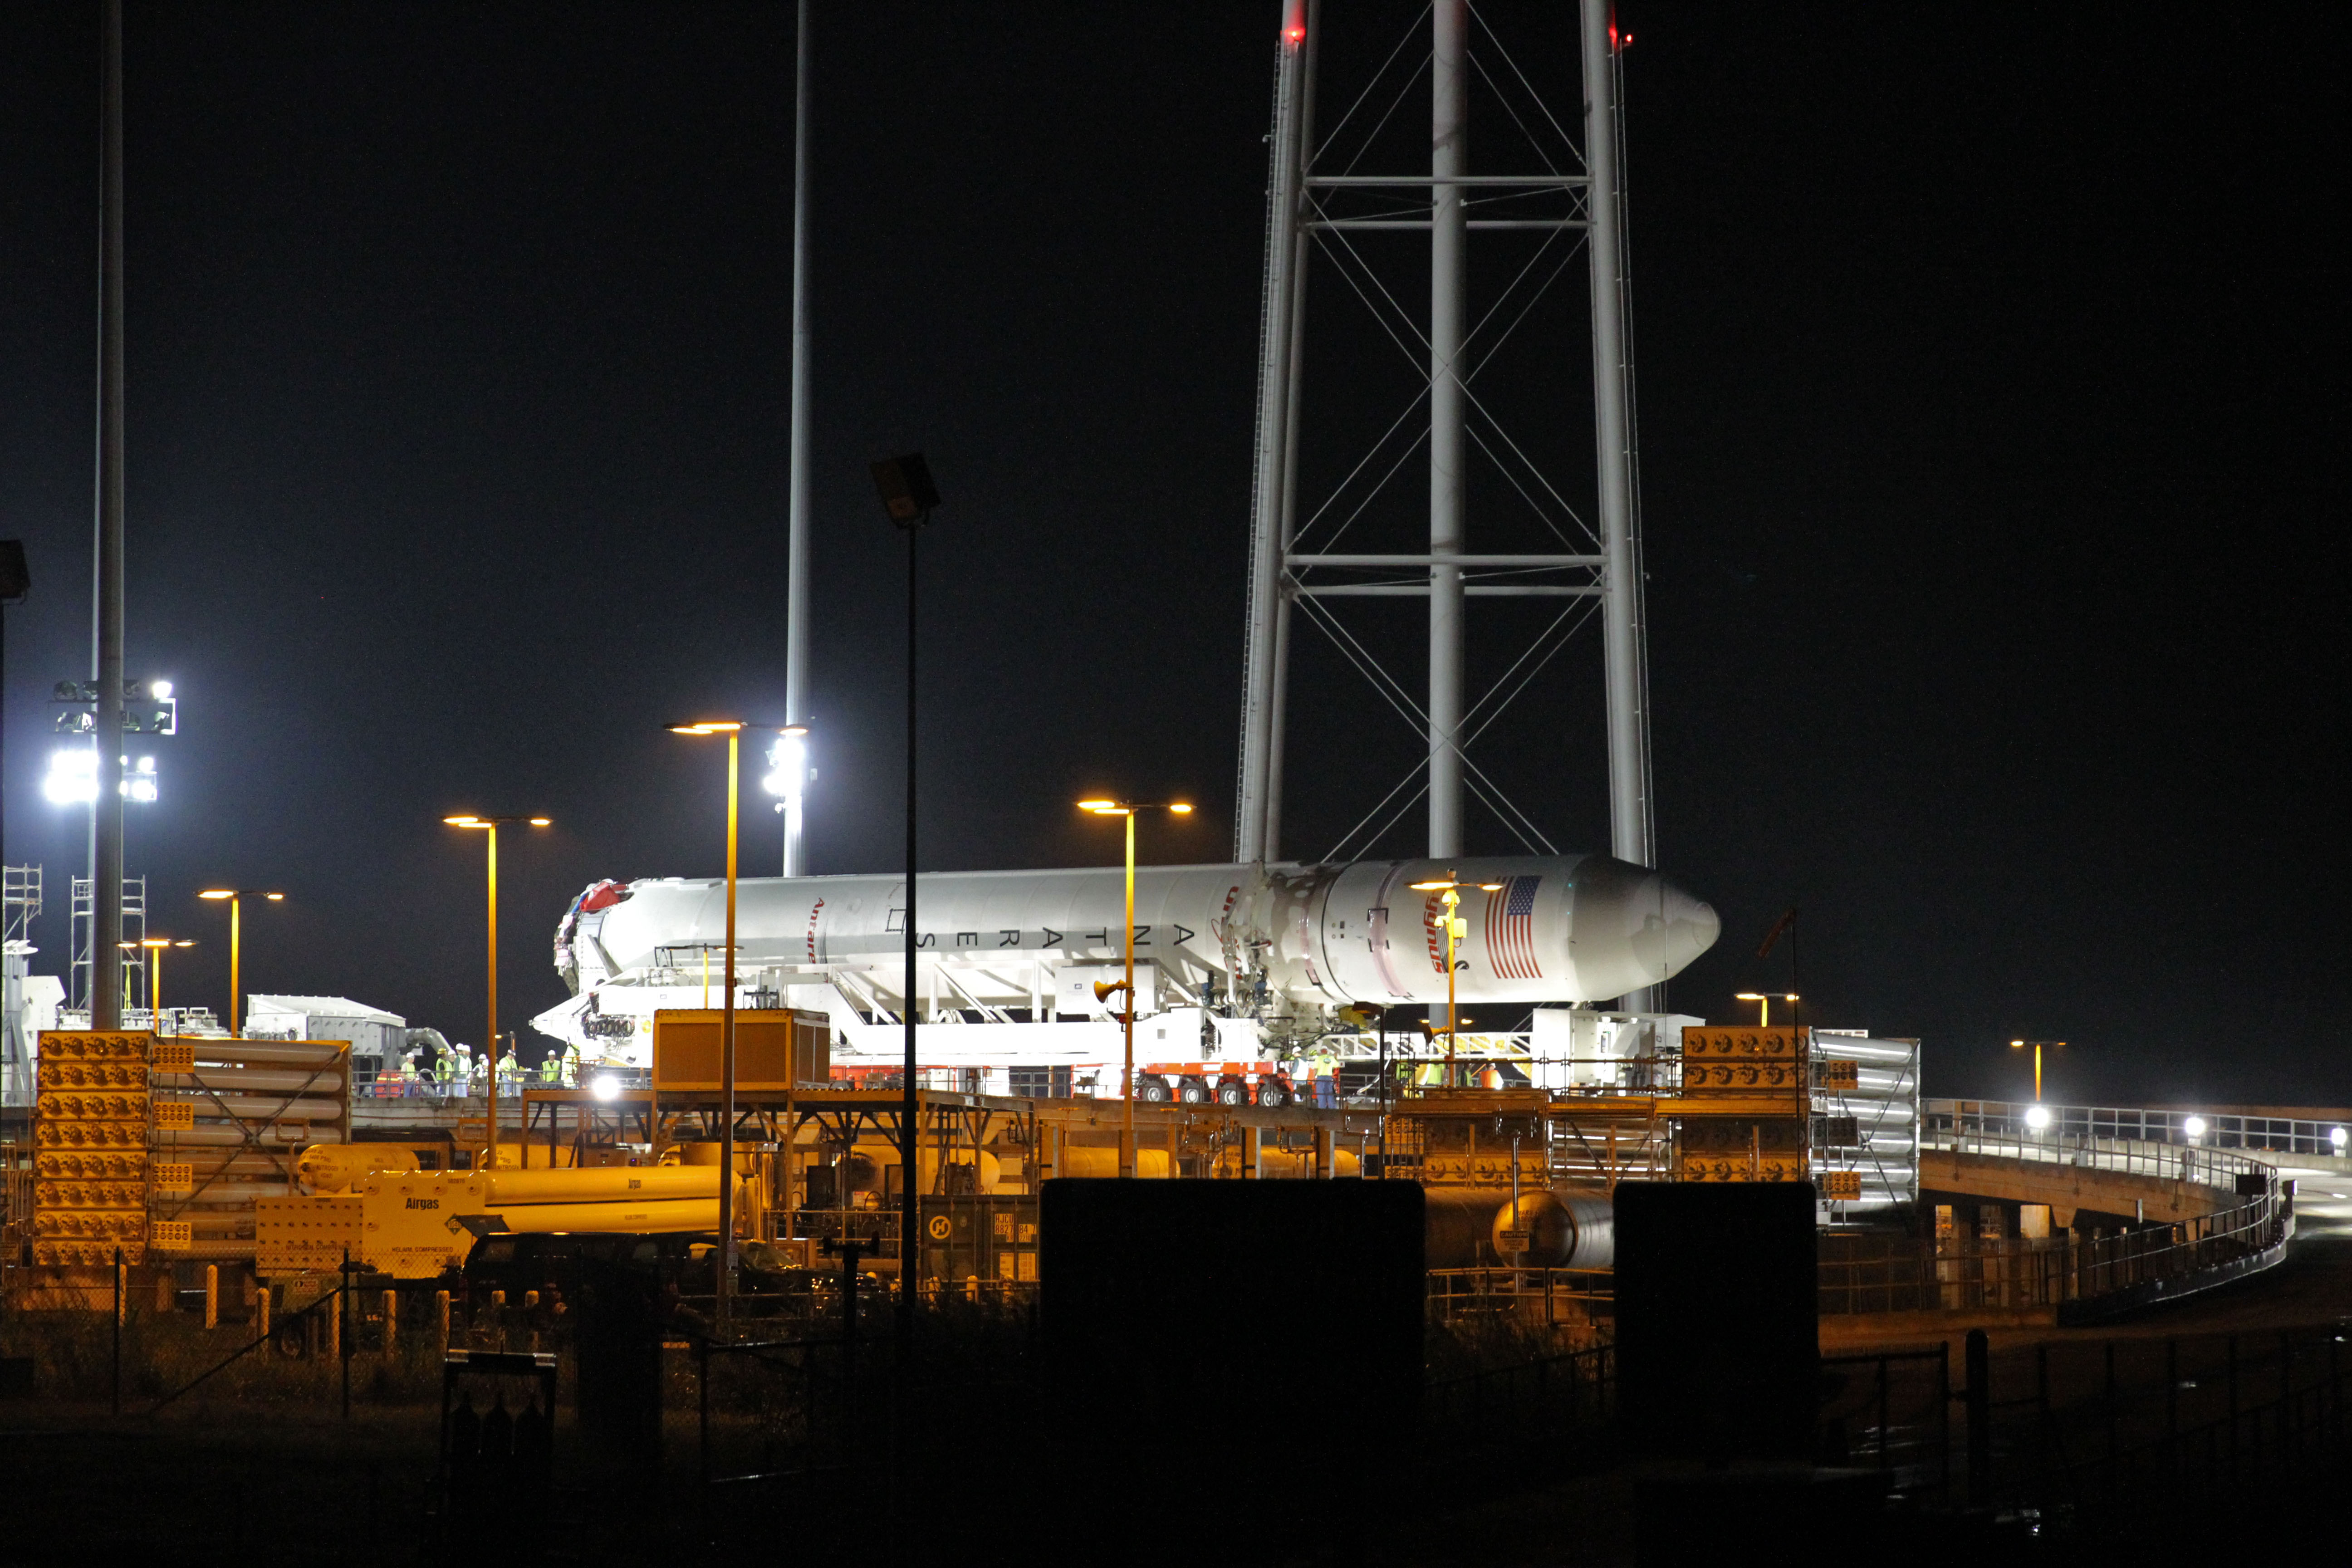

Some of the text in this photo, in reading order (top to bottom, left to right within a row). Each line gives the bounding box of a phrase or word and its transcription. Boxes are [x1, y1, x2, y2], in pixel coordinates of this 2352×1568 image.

[808, 897, 824, 975] Antare
[916, 924, 1195, 949] ANTARES
[1423, 889, 1446, 974] ygnus
[405, 1197, 439, 1210] Airgas
[995, 1214, 1013, 1223] HJCU
[995, 1225, 1013, 1234] 8827
[1019, 1225, 1028, 1234] 84
